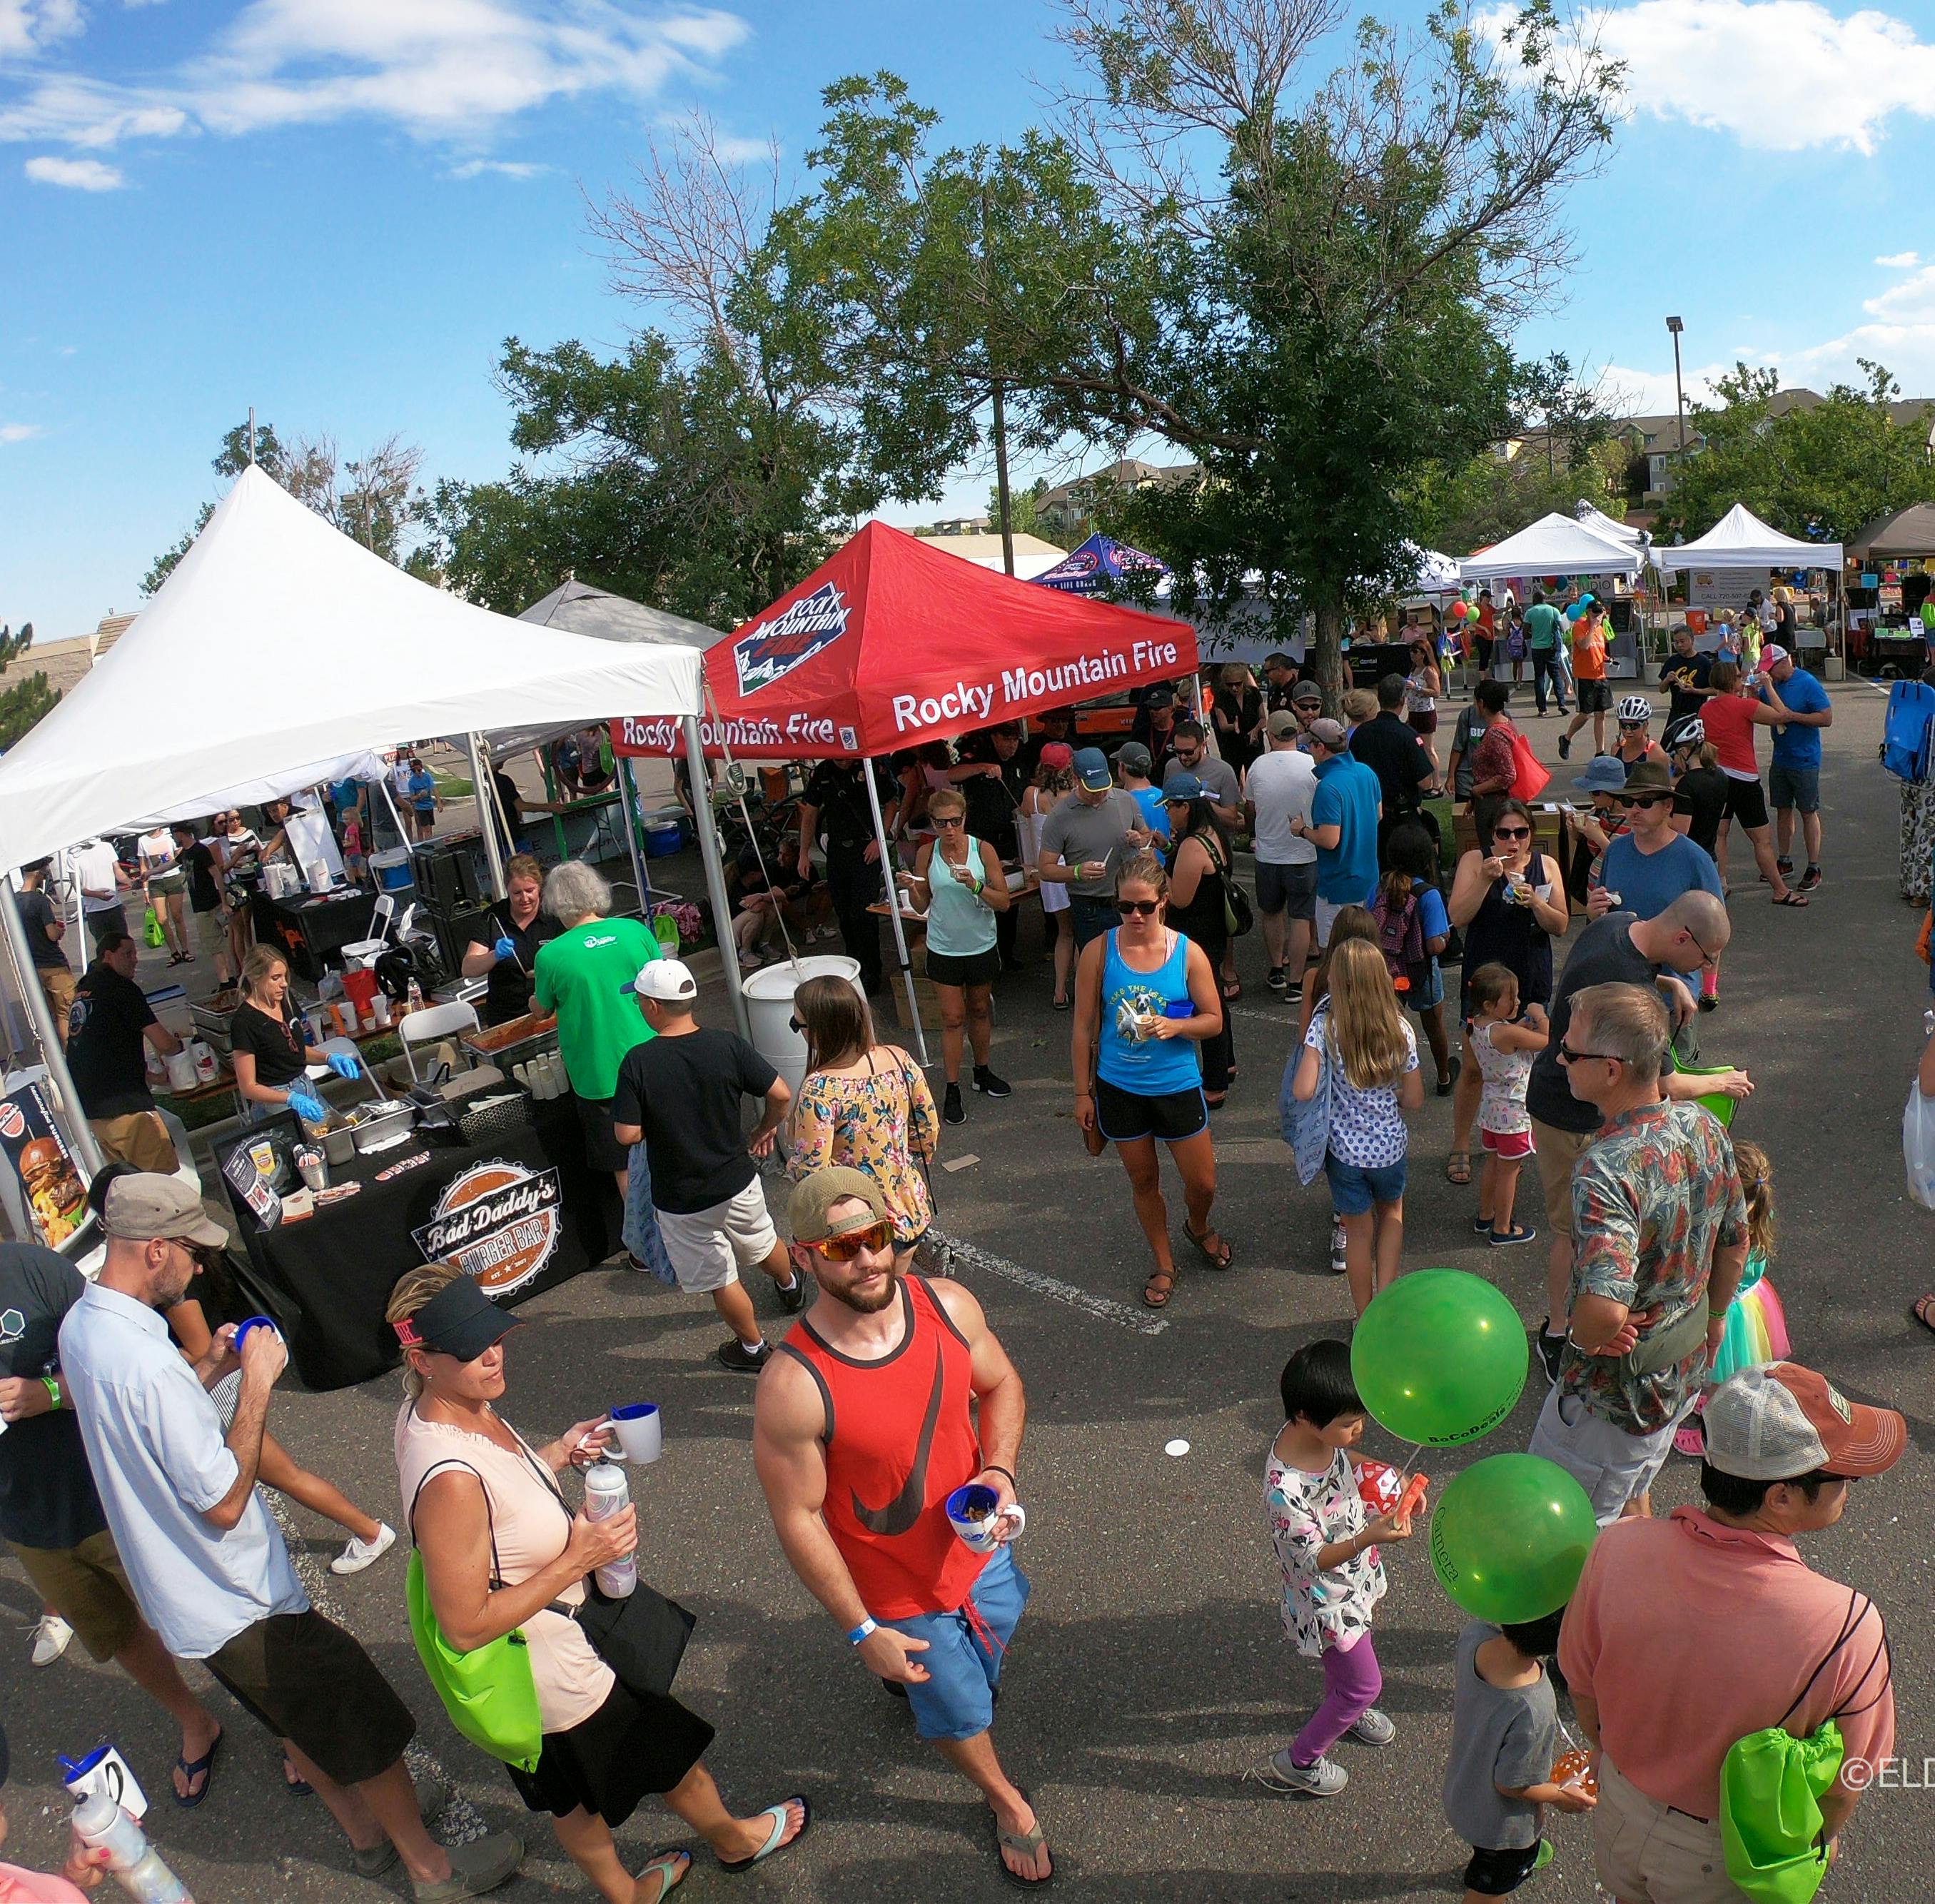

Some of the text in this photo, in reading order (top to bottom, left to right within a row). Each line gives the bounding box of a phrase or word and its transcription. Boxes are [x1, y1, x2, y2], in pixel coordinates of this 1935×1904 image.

[784, 592, 845, 620] ROCKY
[750, 608, 852, 641] MOUNTAIN
[752, 631, 818, 658] FIRE
[892, 640, 1178, 732] Rocky Mountain Fire
[622, 712, 835, 753] Rocky ountain Fire
[1127, 984, 1146, 993] THE
[49, 1124, 69, 1159] BURGERS
[428, 1178, 557, 1253] Bad Daddy's
[458, 1218, 547, 1276] BURGER BAR
[514, 1258, 527, 1268] 2007
